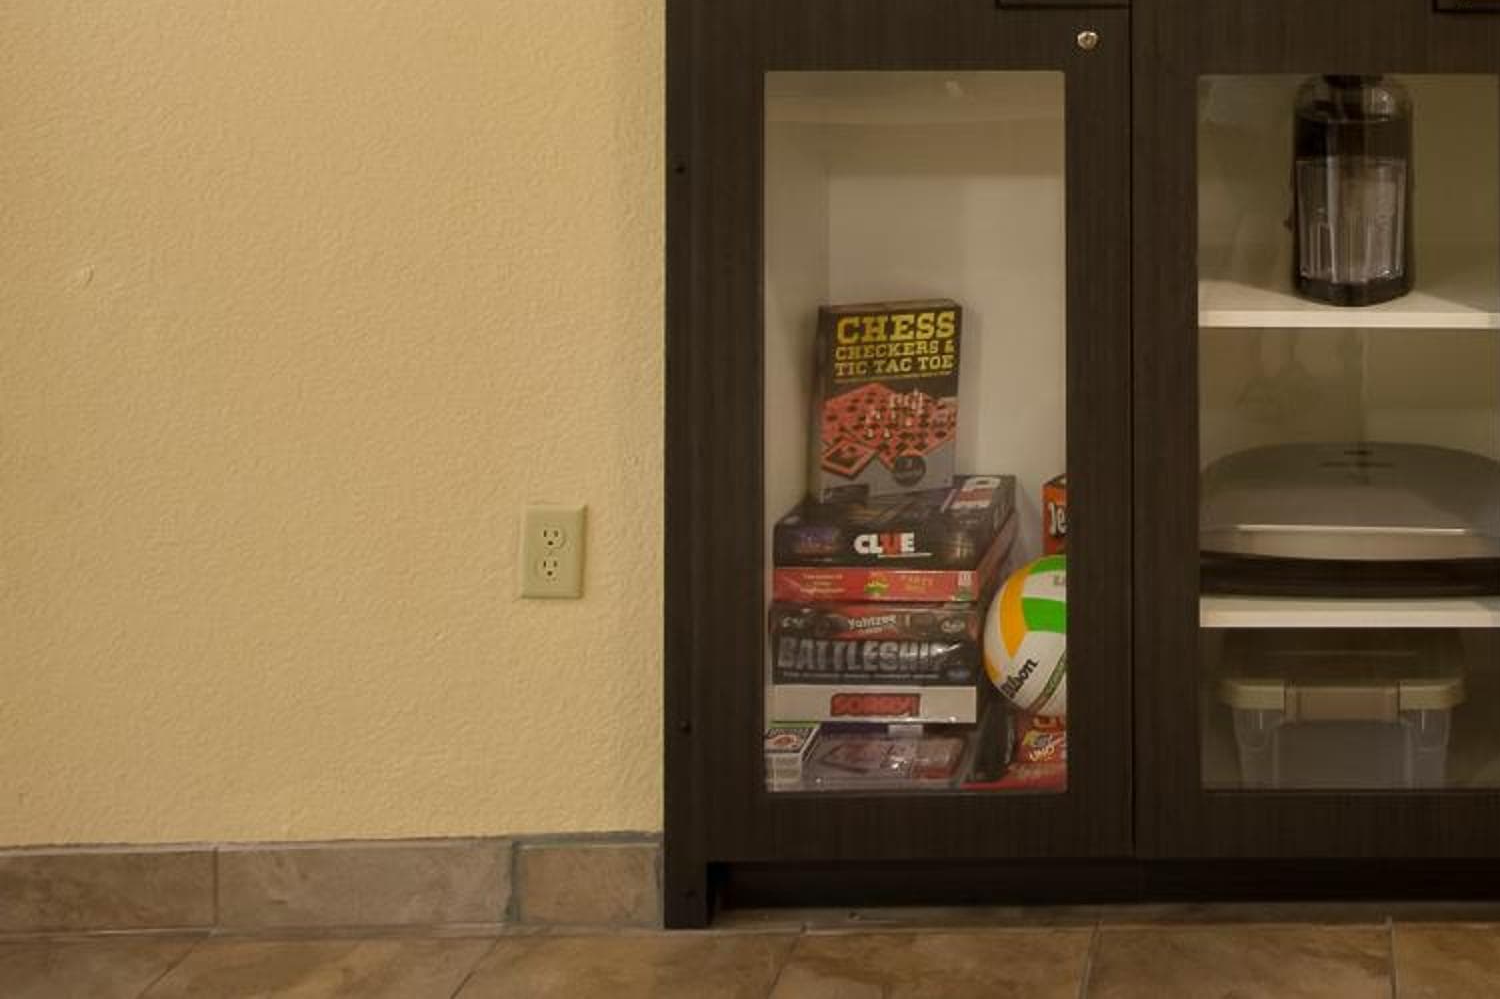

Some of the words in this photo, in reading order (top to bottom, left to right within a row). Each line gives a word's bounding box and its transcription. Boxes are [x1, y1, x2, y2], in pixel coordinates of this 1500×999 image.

[837, 311, 955, 344] CHESS
[836, 339, 938, 360] CHECKERS
[834, 361, 867, 377] TIC
[873, 358, 912, 374] TAC
[918, 354, 954, 371] TOE
[853, 532, 915, 554] CLUE
